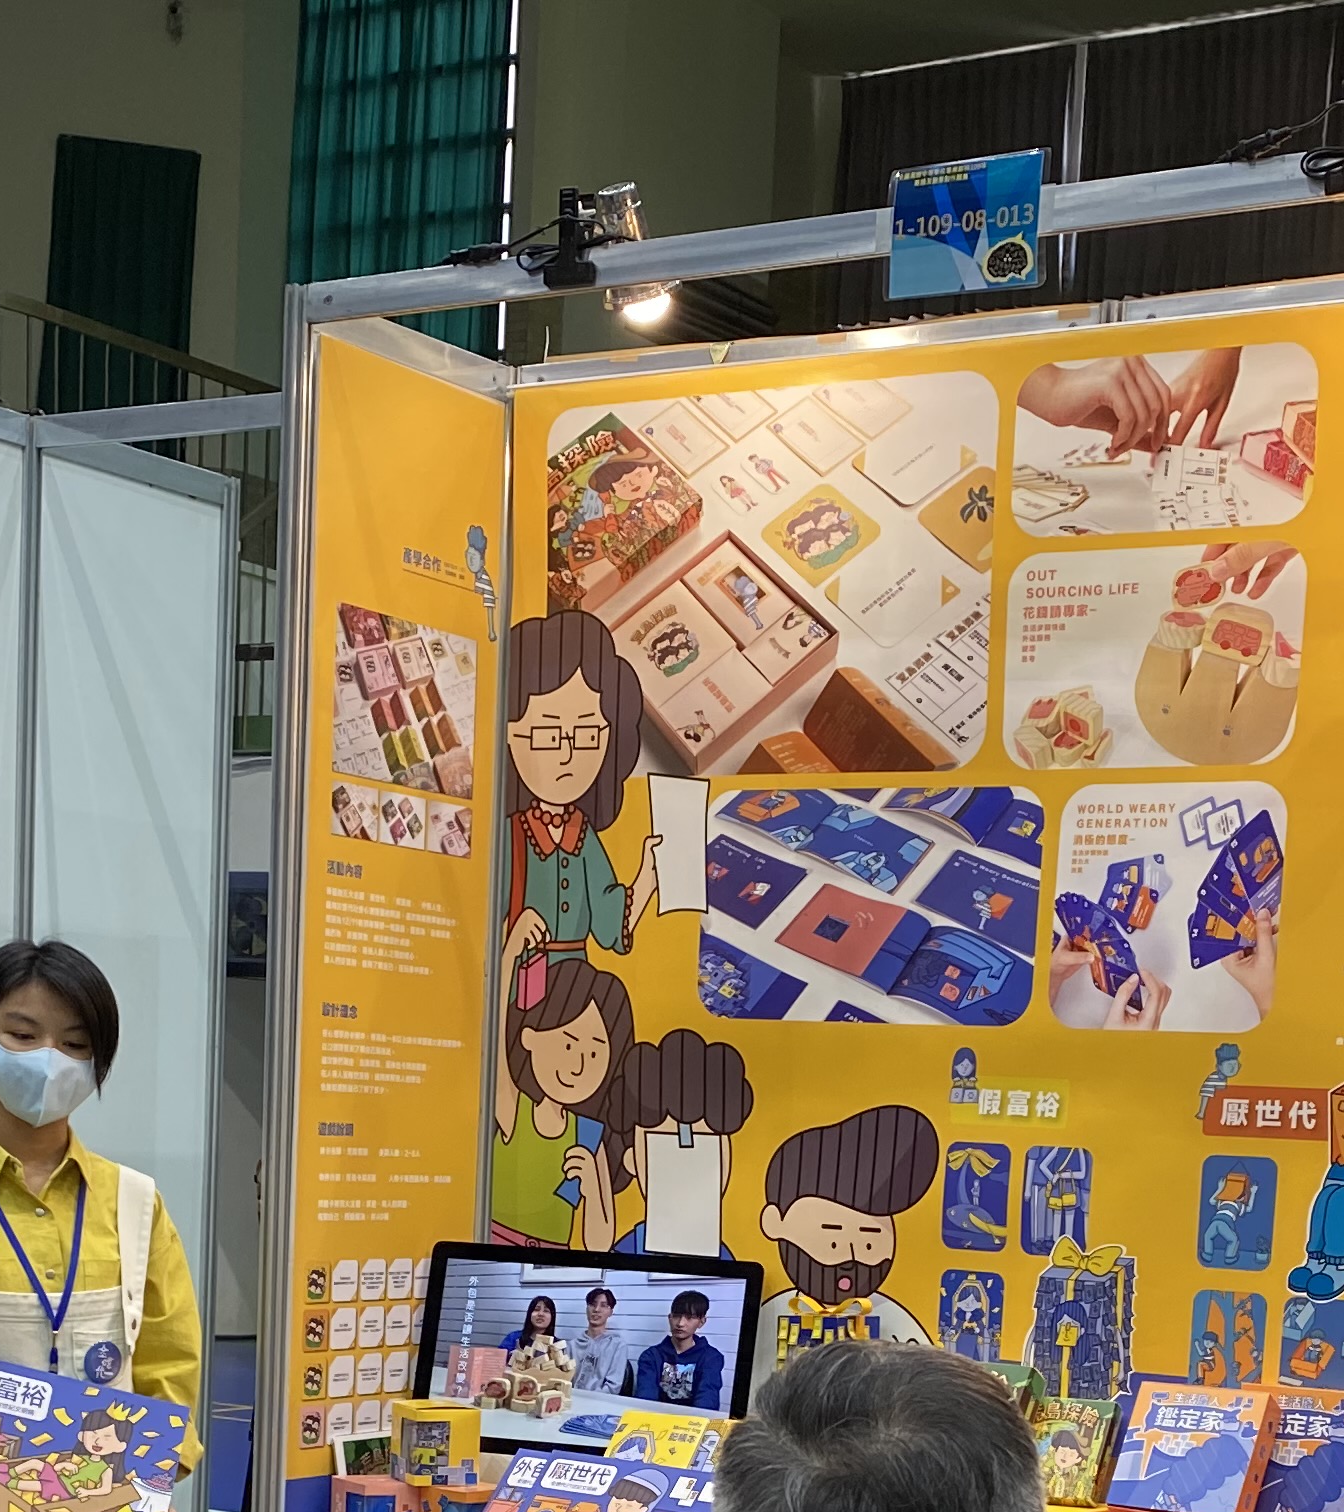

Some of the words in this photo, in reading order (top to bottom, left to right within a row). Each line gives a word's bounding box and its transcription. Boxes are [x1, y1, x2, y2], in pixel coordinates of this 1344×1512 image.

[895, 203, 1035, 239] 1-109-08-013
[1026, 569, 1058, 581] OUT
[1026, 584, 1103, 599] SOURCING
[1108, 583, 1140, 595] LIFE
[1077, 804, 1124, 814] WORLD
[1129, 803, 1176, 813] WEARY
[1076, 818, 1169, 828] GENERATION
[978, 1088, 1060, 1119] 假富裕
[1219, 1097, 1318, 1131] 厭世代
[1156, 1406, 1225, 1432] 鑑定家
[548, 1461, 612, 1486] 厭世代
